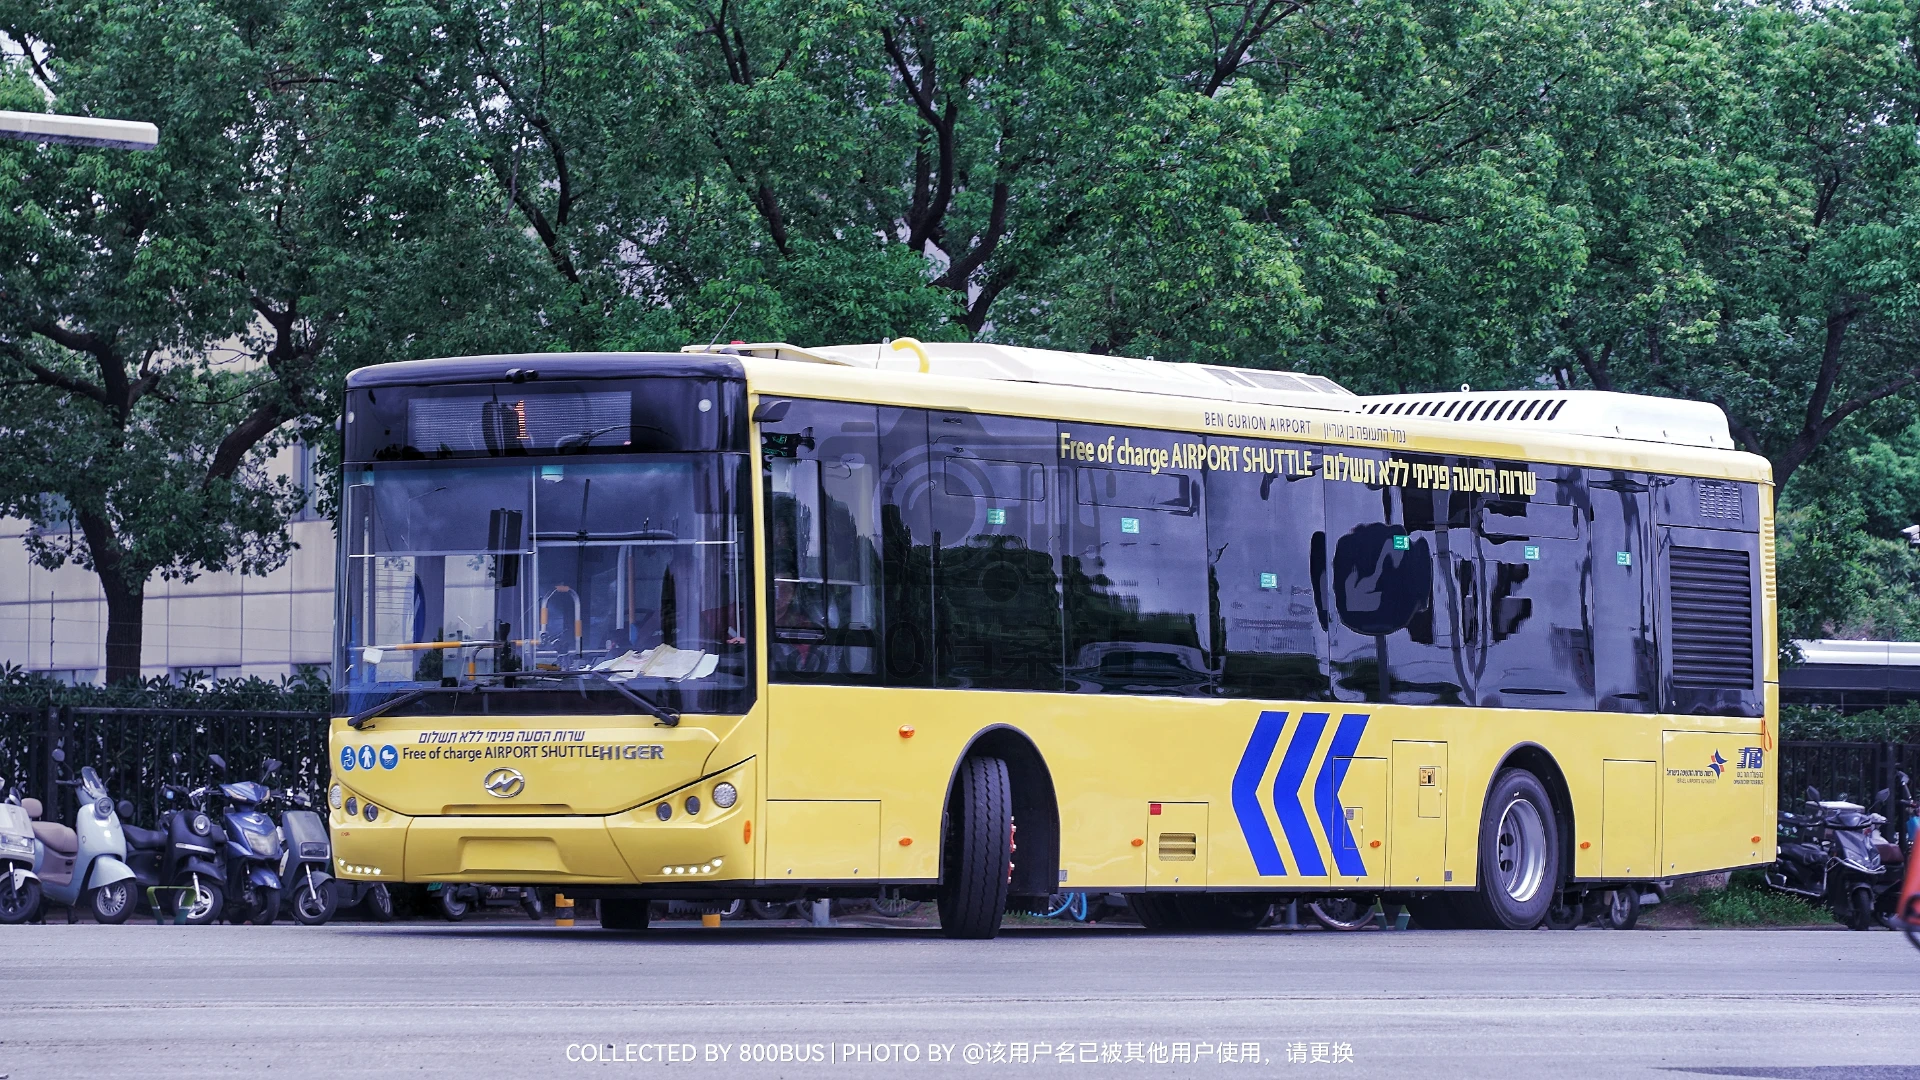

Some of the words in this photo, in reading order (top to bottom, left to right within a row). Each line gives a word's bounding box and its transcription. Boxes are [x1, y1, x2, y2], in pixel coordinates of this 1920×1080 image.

[1204, 411, 1224, 427] BEN
[1227, 413, 1267, 431] GURION
[1270, 417, 1312, 435] AIRPORT
[1346, 424, 1355, 442] בן
[1060, 432, 1094, 461] Free
[1097, 436, 1116, 463] of
[1117, 438, 1169, 475] charge
[1171, 442, 1240, 471] AIRPORT
[1243, 446, 1313, 476] SHUTTLE
[1323, 453, 1375, 485] תשלום
[1378, 457, 1409, 487] ללא
[1412, 462, 1450, 491] פנימי
[1453, 466, 1496, 493] הסעה
[1498, 469, 1537, 495] שרות
[418, 730, 457, 744] תשלום
[458, 730, 483, 743] ללא
[486, 731, 514, 742] פנימי
[516, 730, 551, 742] הסעה
[552, 730, 586, 742] שרות
[403, 747, 426, 759] Free
[429, 746, 441, 759] of
[443, 746, 482, 762] charge
[484, 745, 538, 759] AIRPORT
[541, 745, 599, 758] SHUTTLE
[599, 744, 665, 760] HIGER
